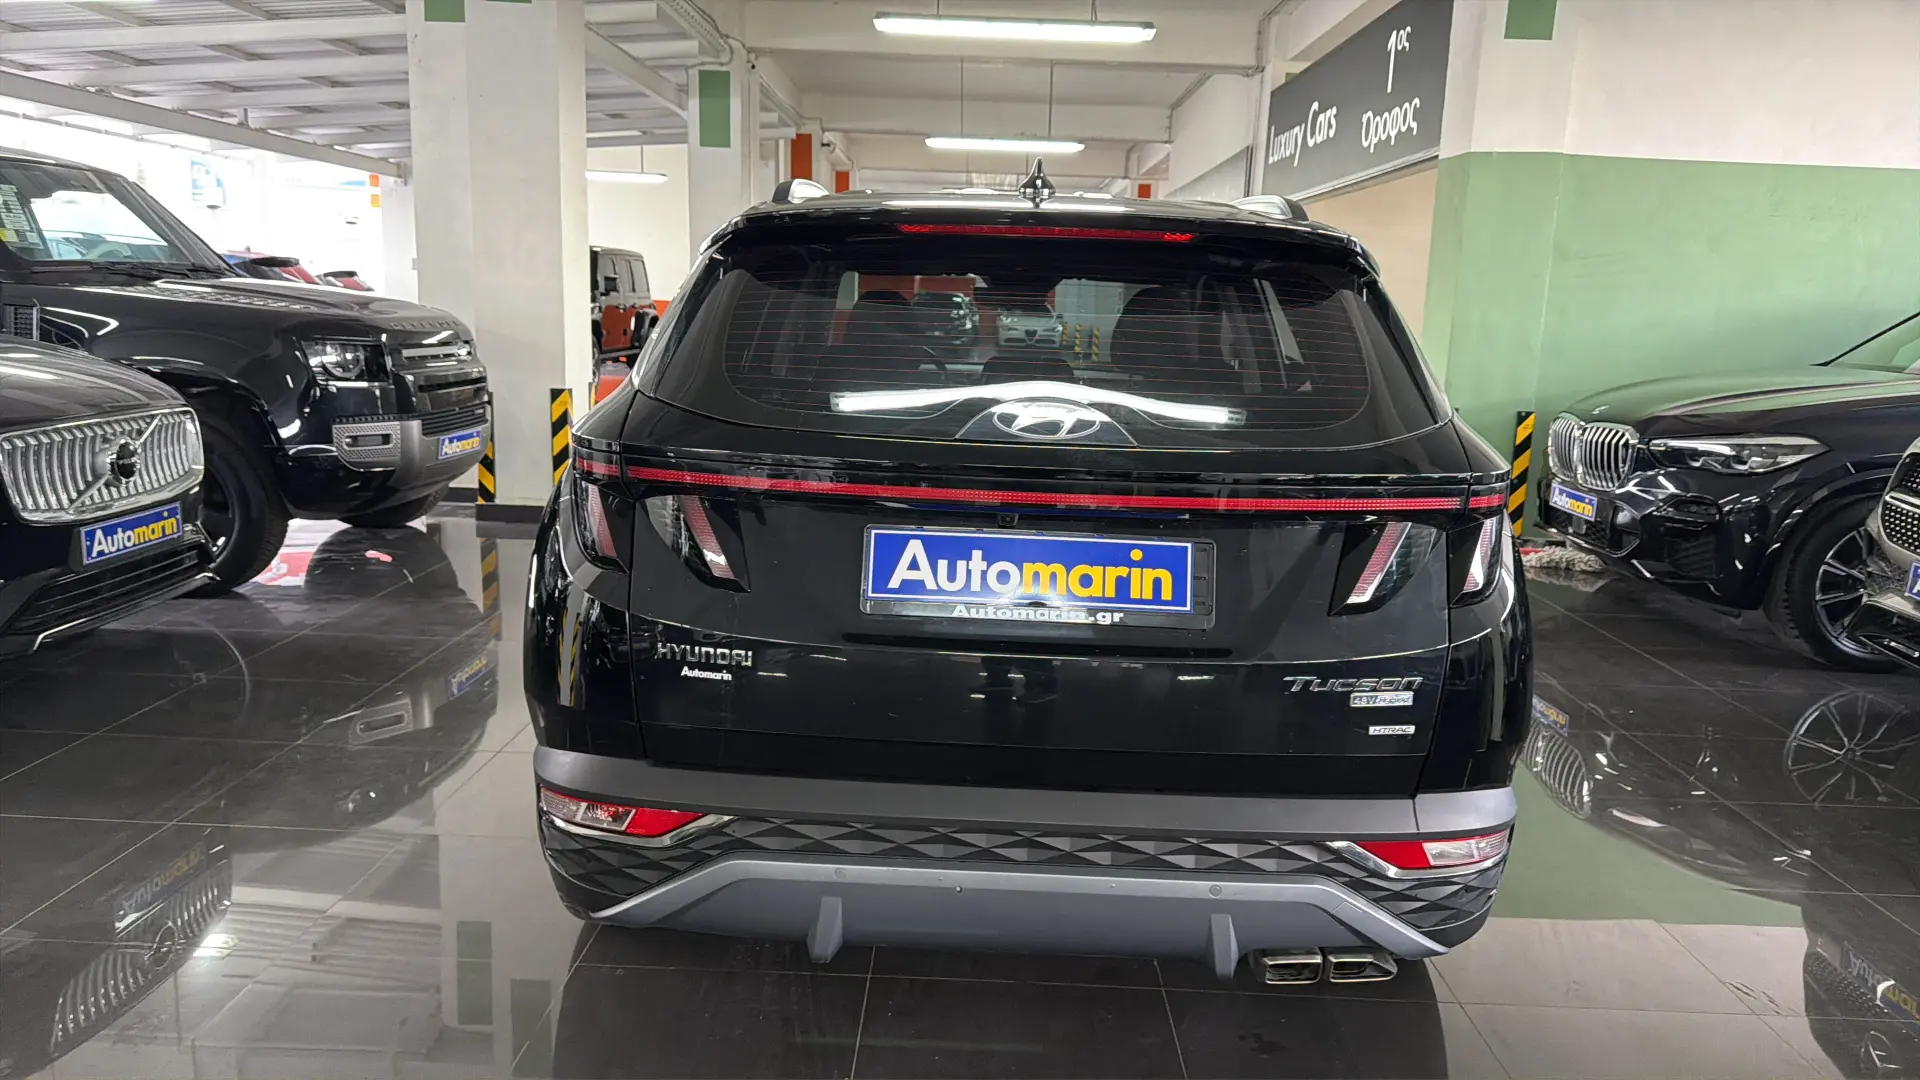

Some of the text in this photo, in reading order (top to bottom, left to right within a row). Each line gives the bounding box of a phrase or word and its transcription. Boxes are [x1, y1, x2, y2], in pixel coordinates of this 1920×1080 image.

[1268, 101, 1337, 167] Luxury Cars
[441, 432, 480, 456] Automarin
[1551, 487, 1593, 517] Automarin
[91, 511, 178, 558] Automarin
[887, 538, 1173, 601] Automarin
[951, 604, 1124, 625] Automarin.gr
[656, 642, 753, 667] HYUNDAI
[680, 665, 732, 681] Automarin
